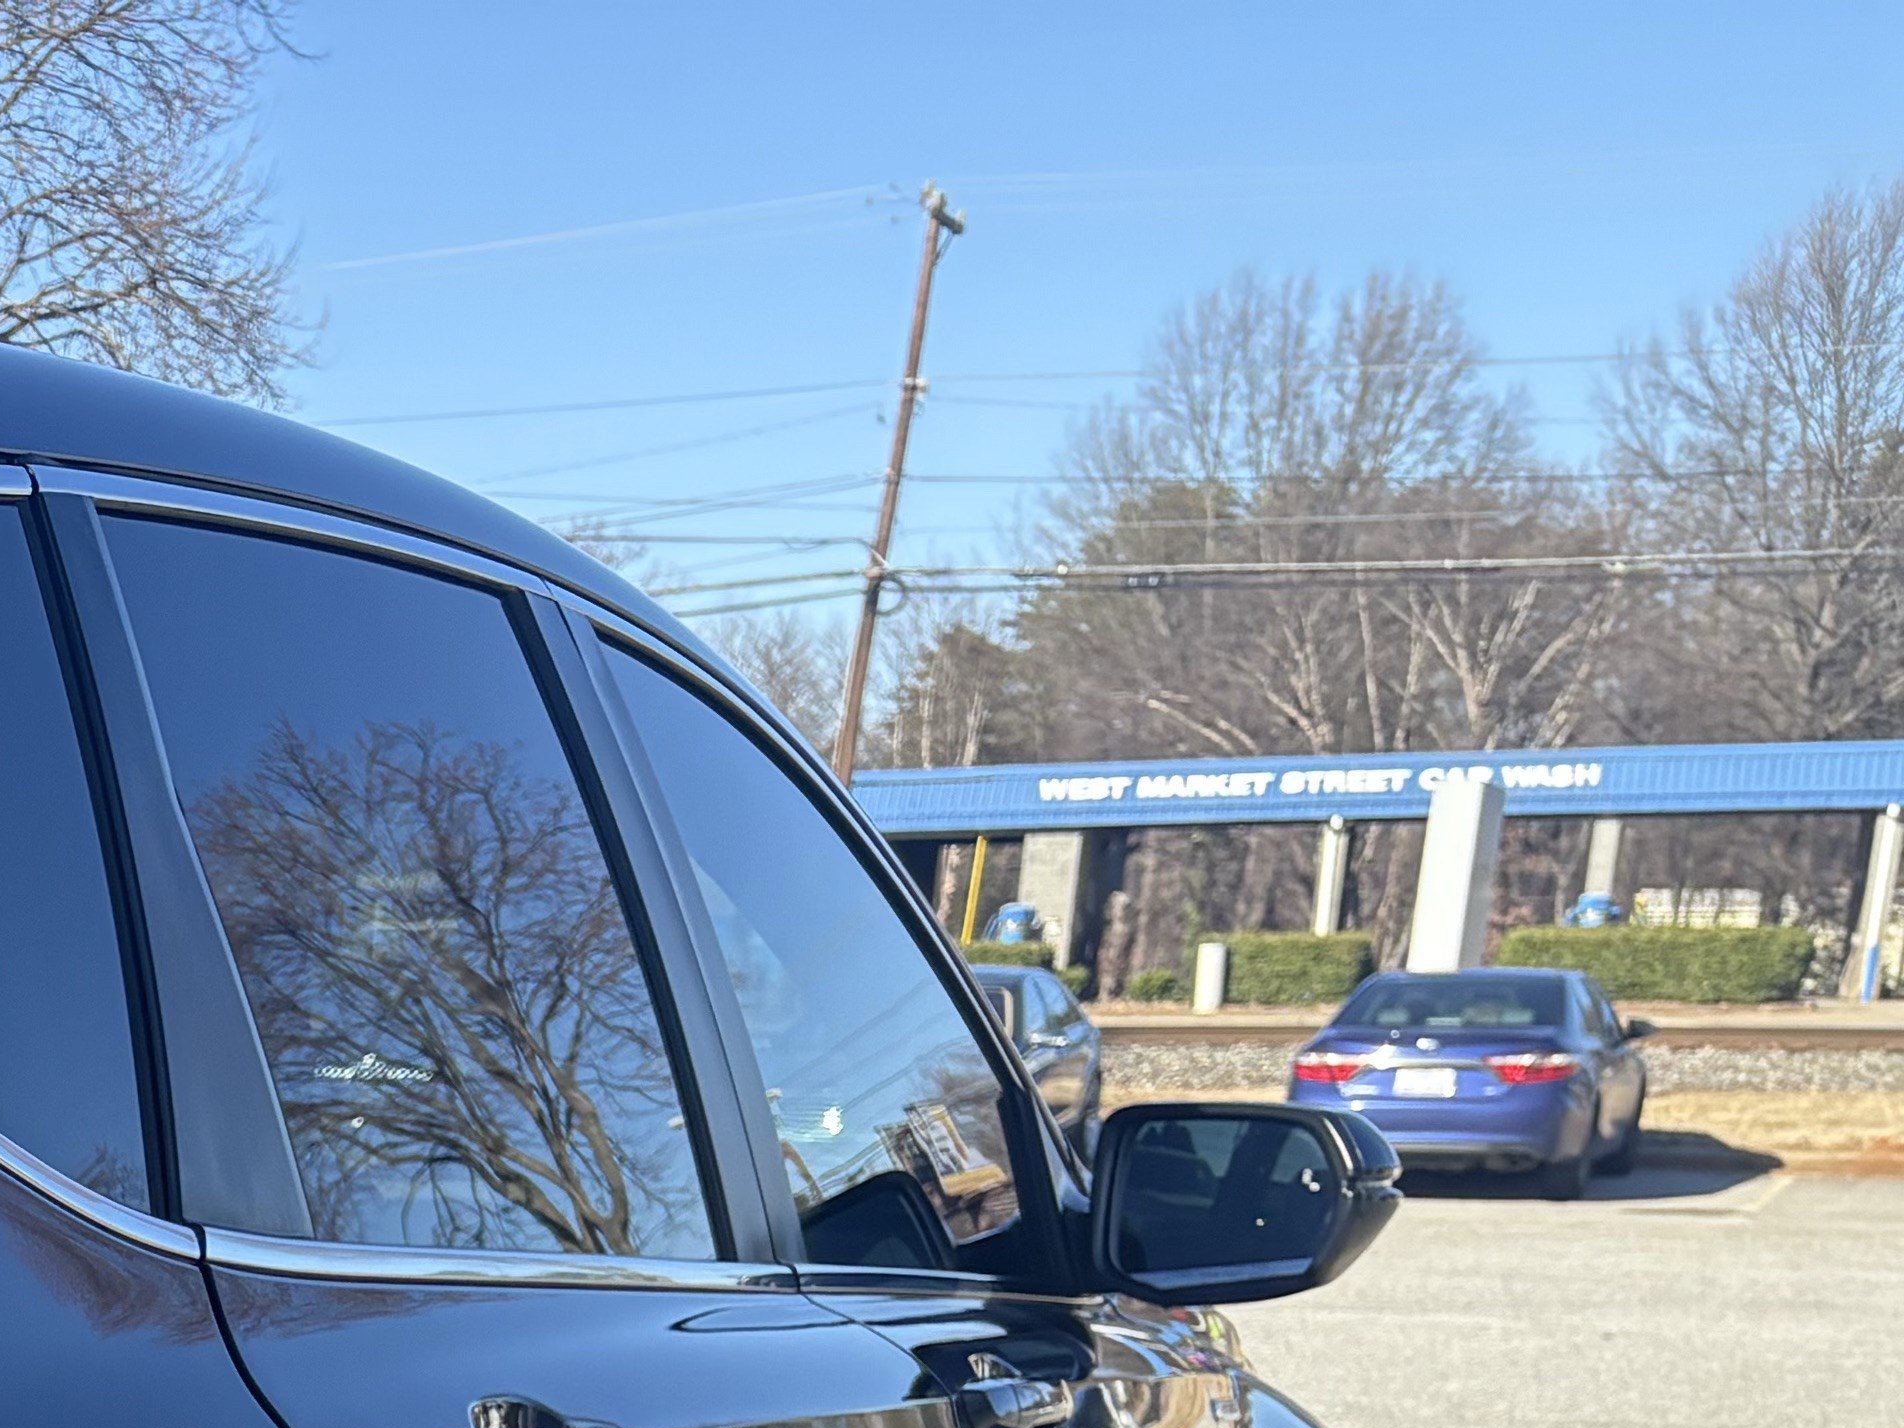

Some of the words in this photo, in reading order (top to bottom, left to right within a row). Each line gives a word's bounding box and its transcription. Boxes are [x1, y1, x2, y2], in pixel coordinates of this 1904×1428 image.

[1038, 777, 1133, 801] WEST
[1135, 772, 1275, 798] MARKET
[1279, 769, 1411, 795] STREET
[1501, 763, 1603, 789] WASH
